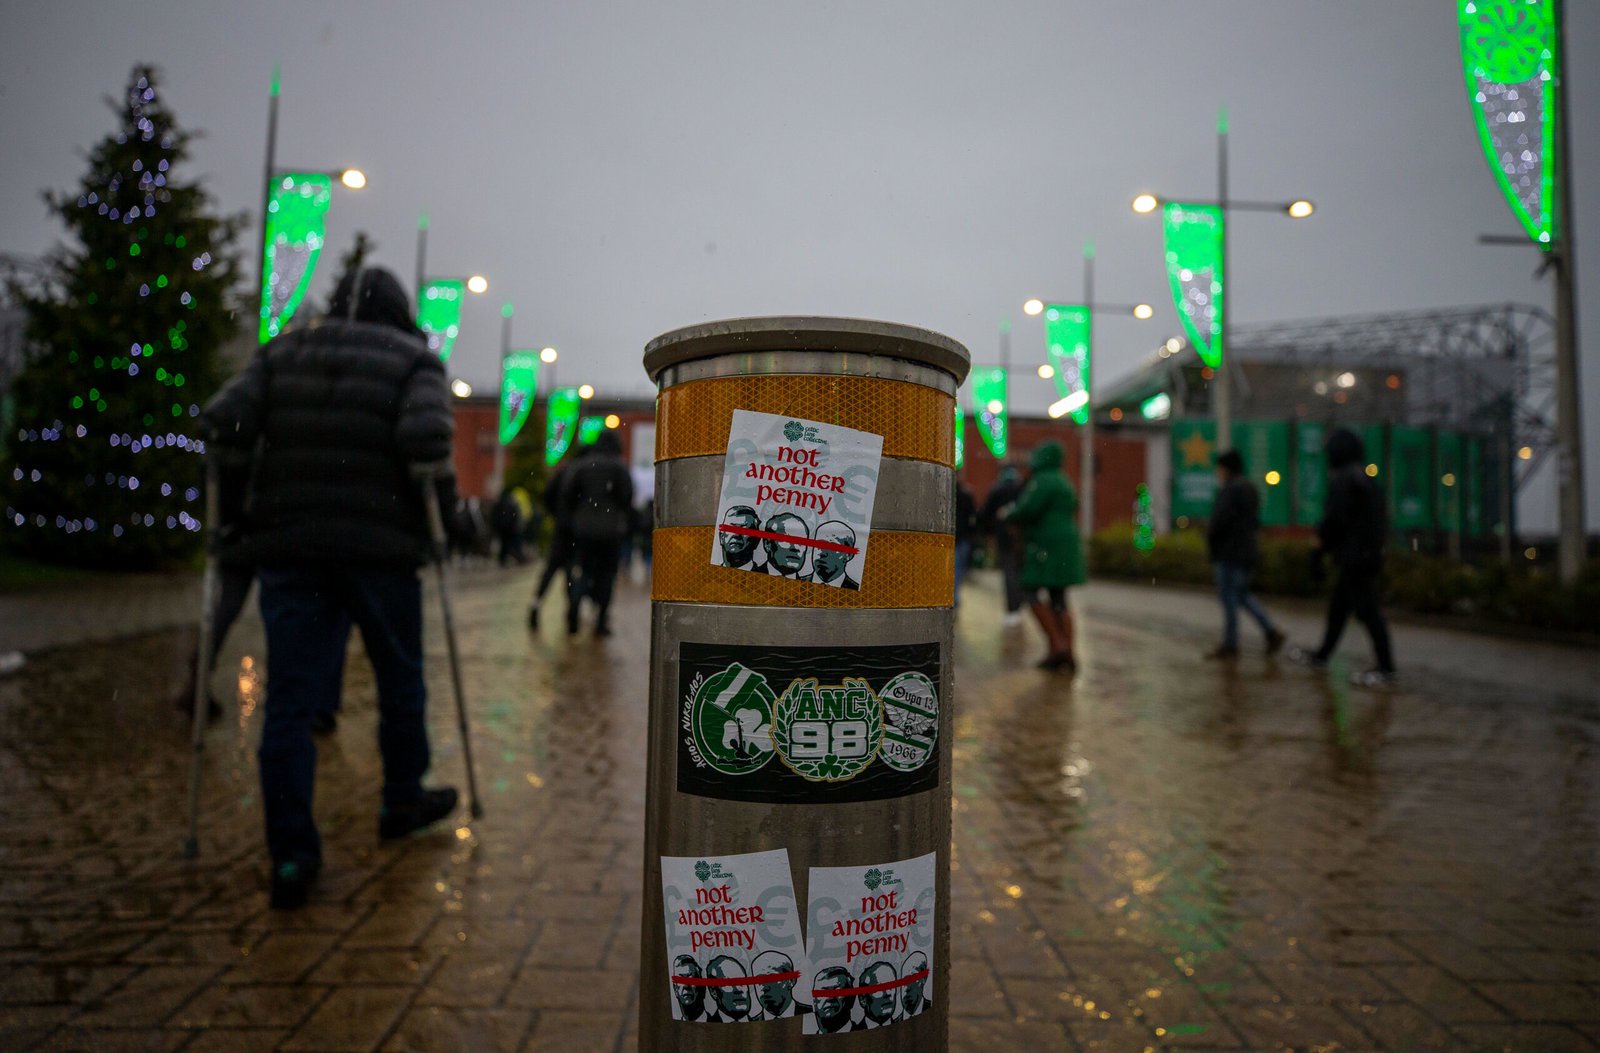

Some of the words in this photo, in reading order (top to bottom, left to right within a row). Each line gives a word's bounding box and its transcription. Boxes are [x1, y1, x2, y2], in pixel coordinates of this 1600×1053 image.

[777, 446, 821, 467] not
[745, 462, 845, 494] another
[756, 484, 832, 515] penny
[681, 671, 704, 732] NIKOLAOS
[795, 689, 867, 720] ANC
[684, 736, 707, 769] AGIOS
[791, 721, 869, 759] 98
[890, 742, 917, 760] 1966
[695, 884, 733, 905] not
[861, 890, 898, 913] not
[678, 905, 765, 926] another
[832, 908, 917, 937] another
[690, 928, 755, 953] penny
[846, 931, 910, 963] penny
